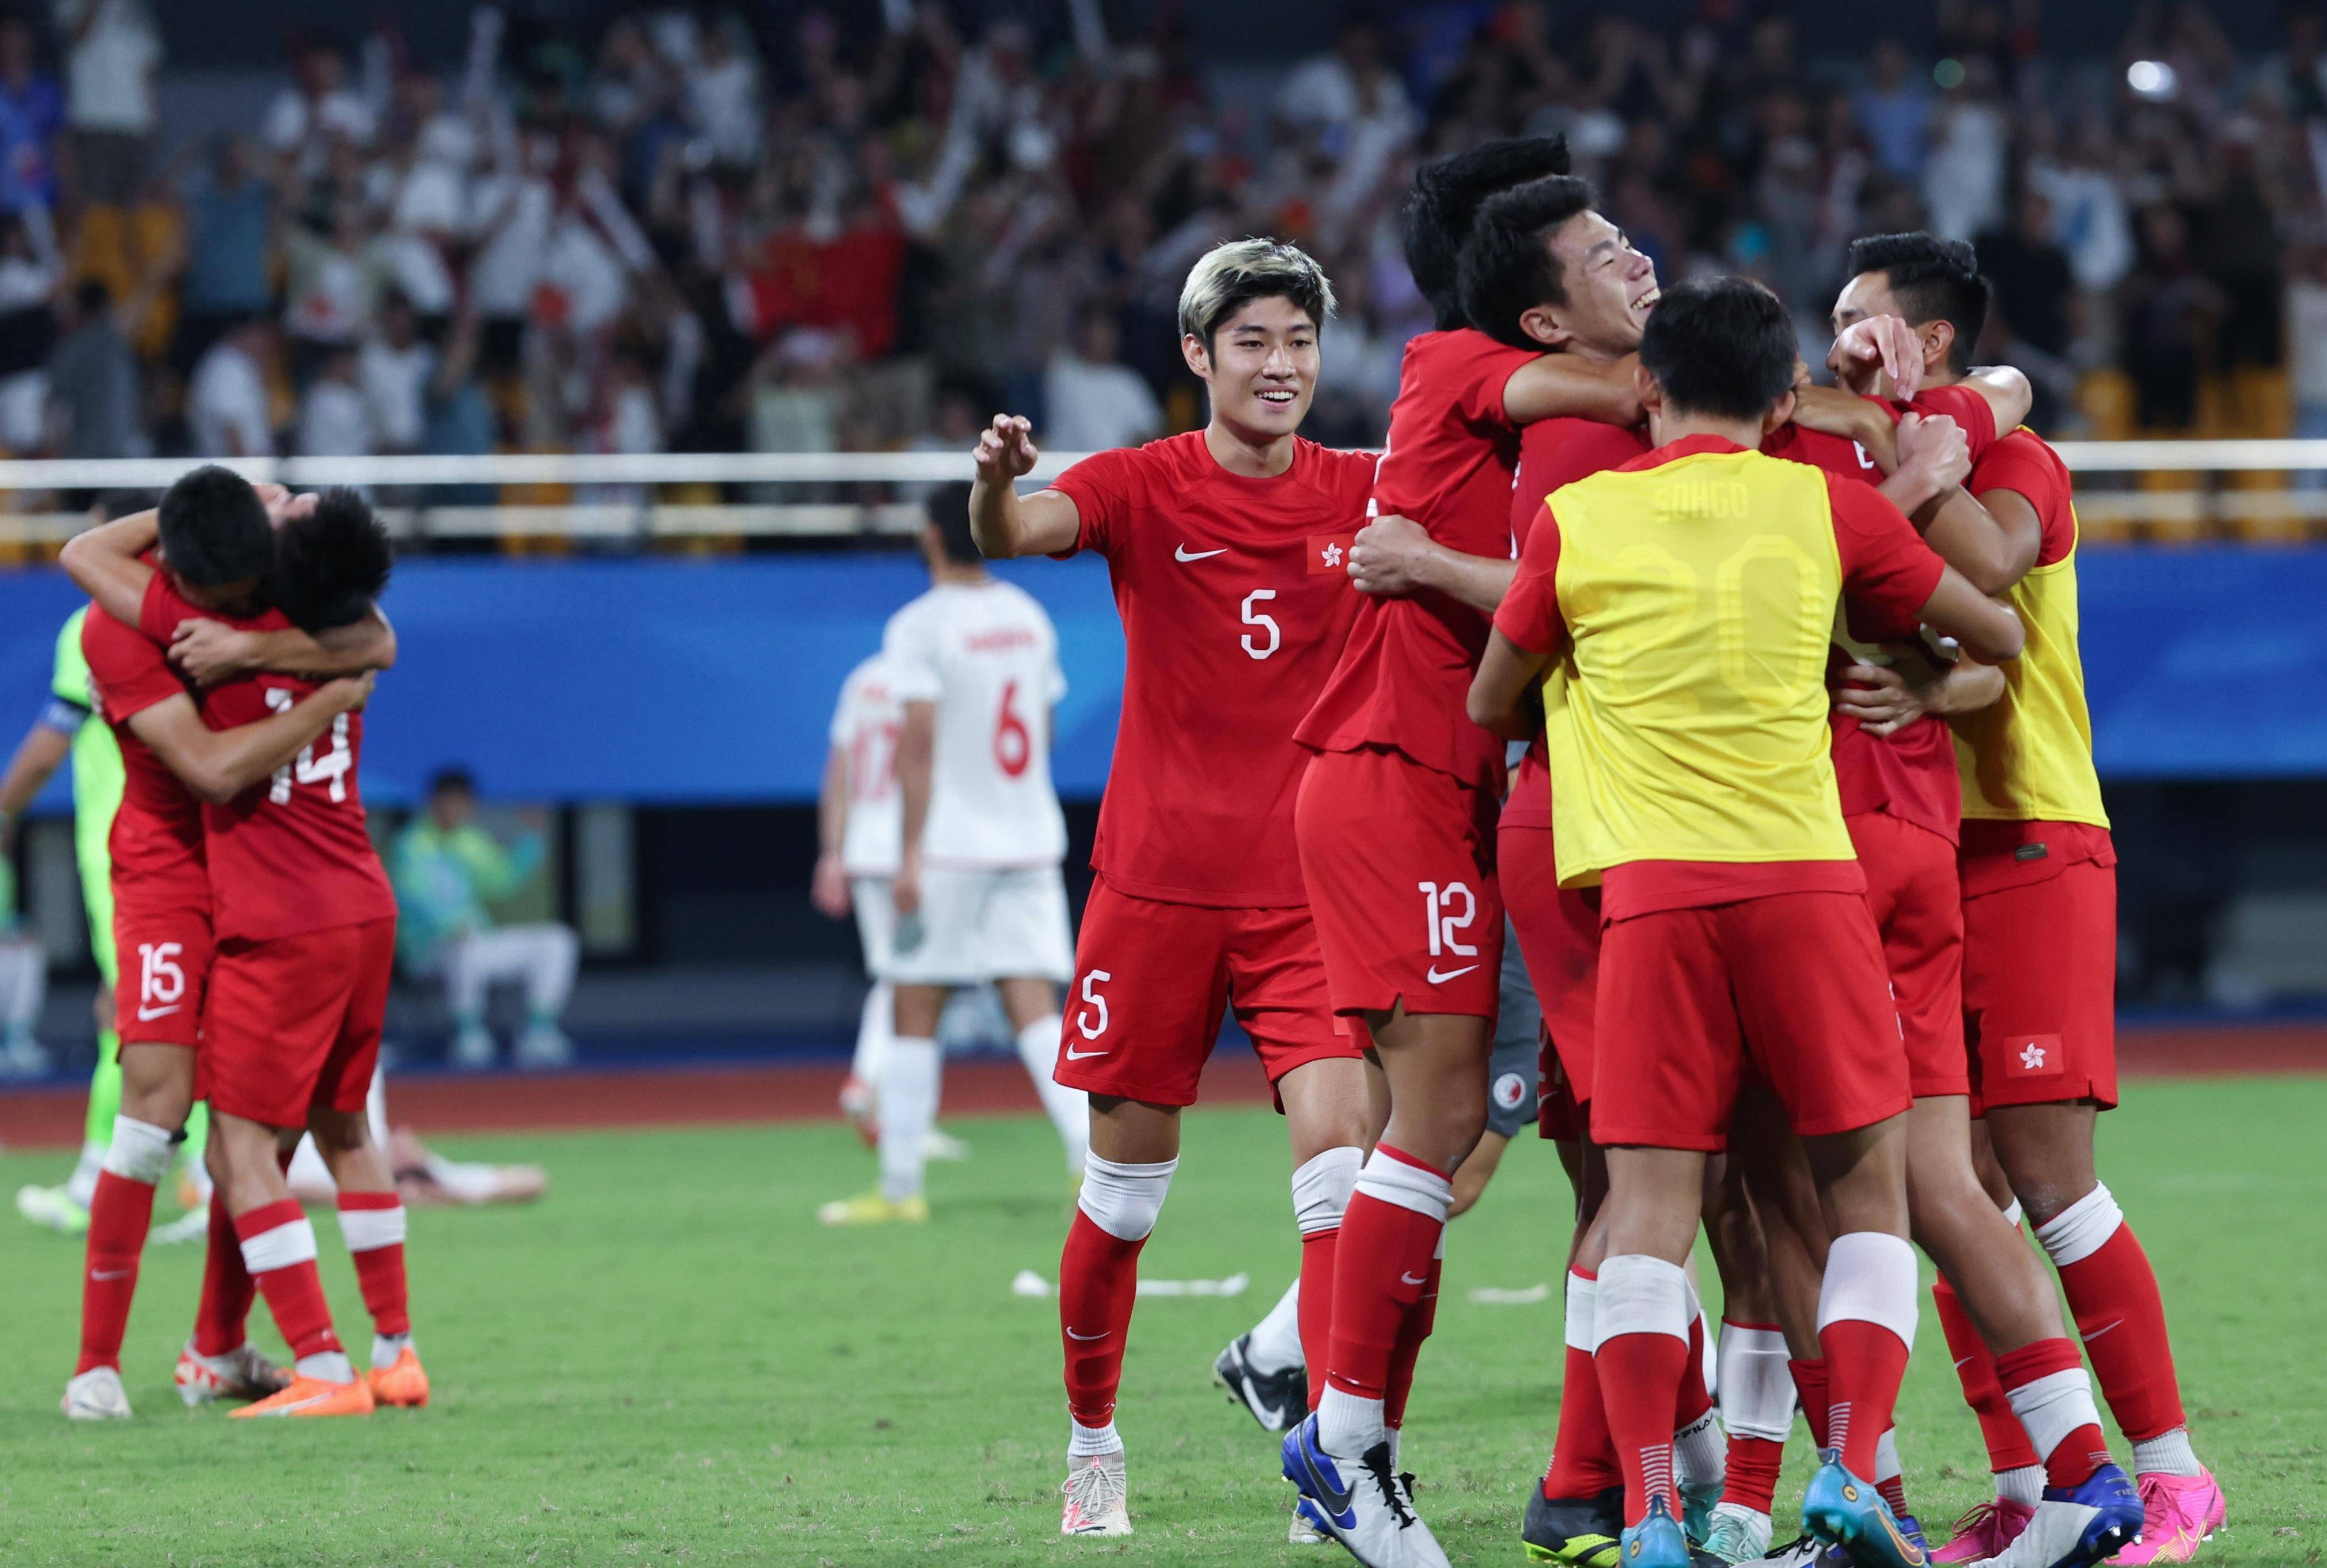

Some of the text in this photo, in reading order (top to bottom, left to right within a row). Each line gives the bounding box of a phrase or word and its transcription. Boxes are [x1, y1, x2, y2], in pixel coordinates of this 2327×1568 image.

[1241, 589, 1280, 660] 5
[264, 687, 353, 805] 14
[992, 675, 1031, 780] 6
[1418, 881, 1477, 956] 12
[138, 941, 185, 1003] 15
[1077, 969, 1111, 1040] 5
